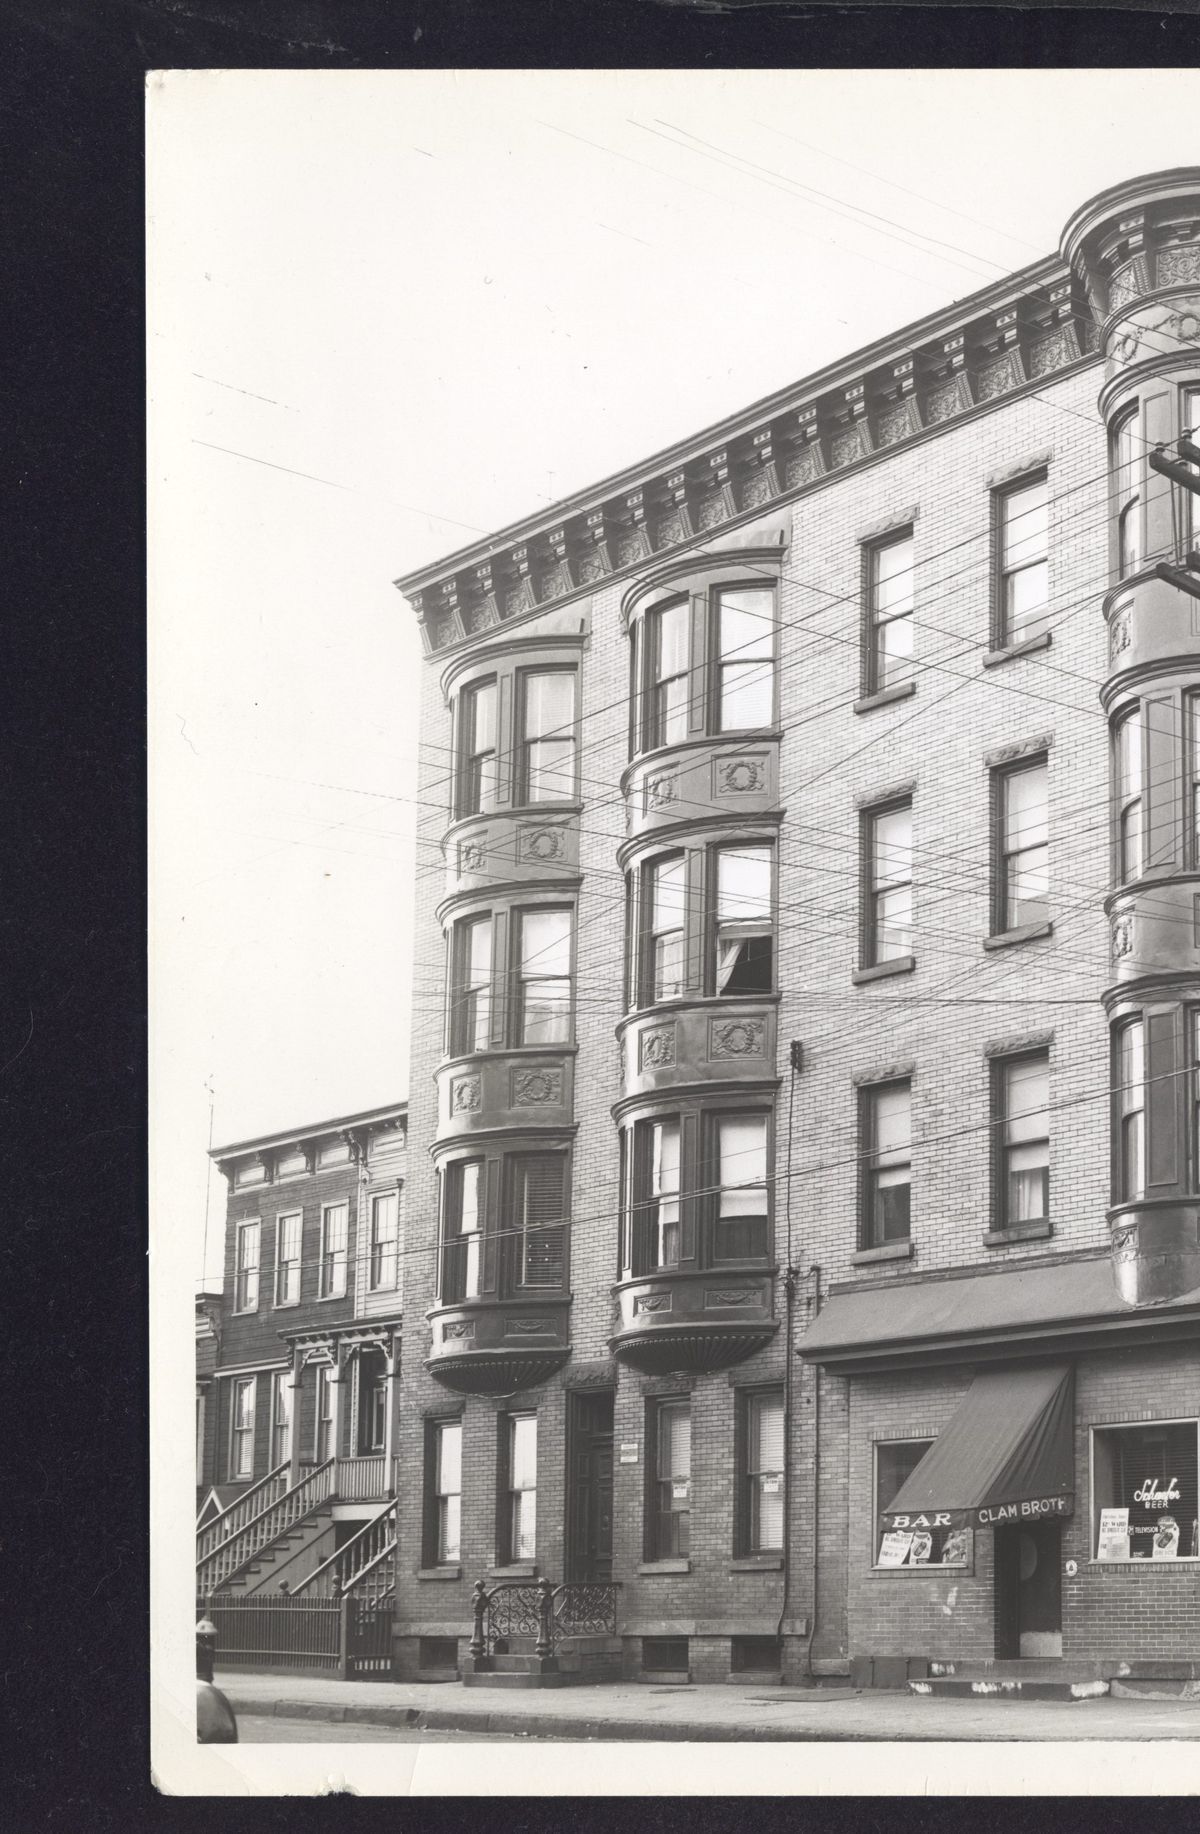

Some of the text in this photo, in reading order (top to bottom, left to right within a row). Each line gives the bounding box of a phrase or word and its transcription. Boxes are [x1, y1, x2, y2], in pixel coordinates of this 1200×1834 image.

[1144, 1500, 1169, 1509] BEER
[891, 1513, 951, 1529] BAR
[978, 1507, 1018, 1524] CLAM
